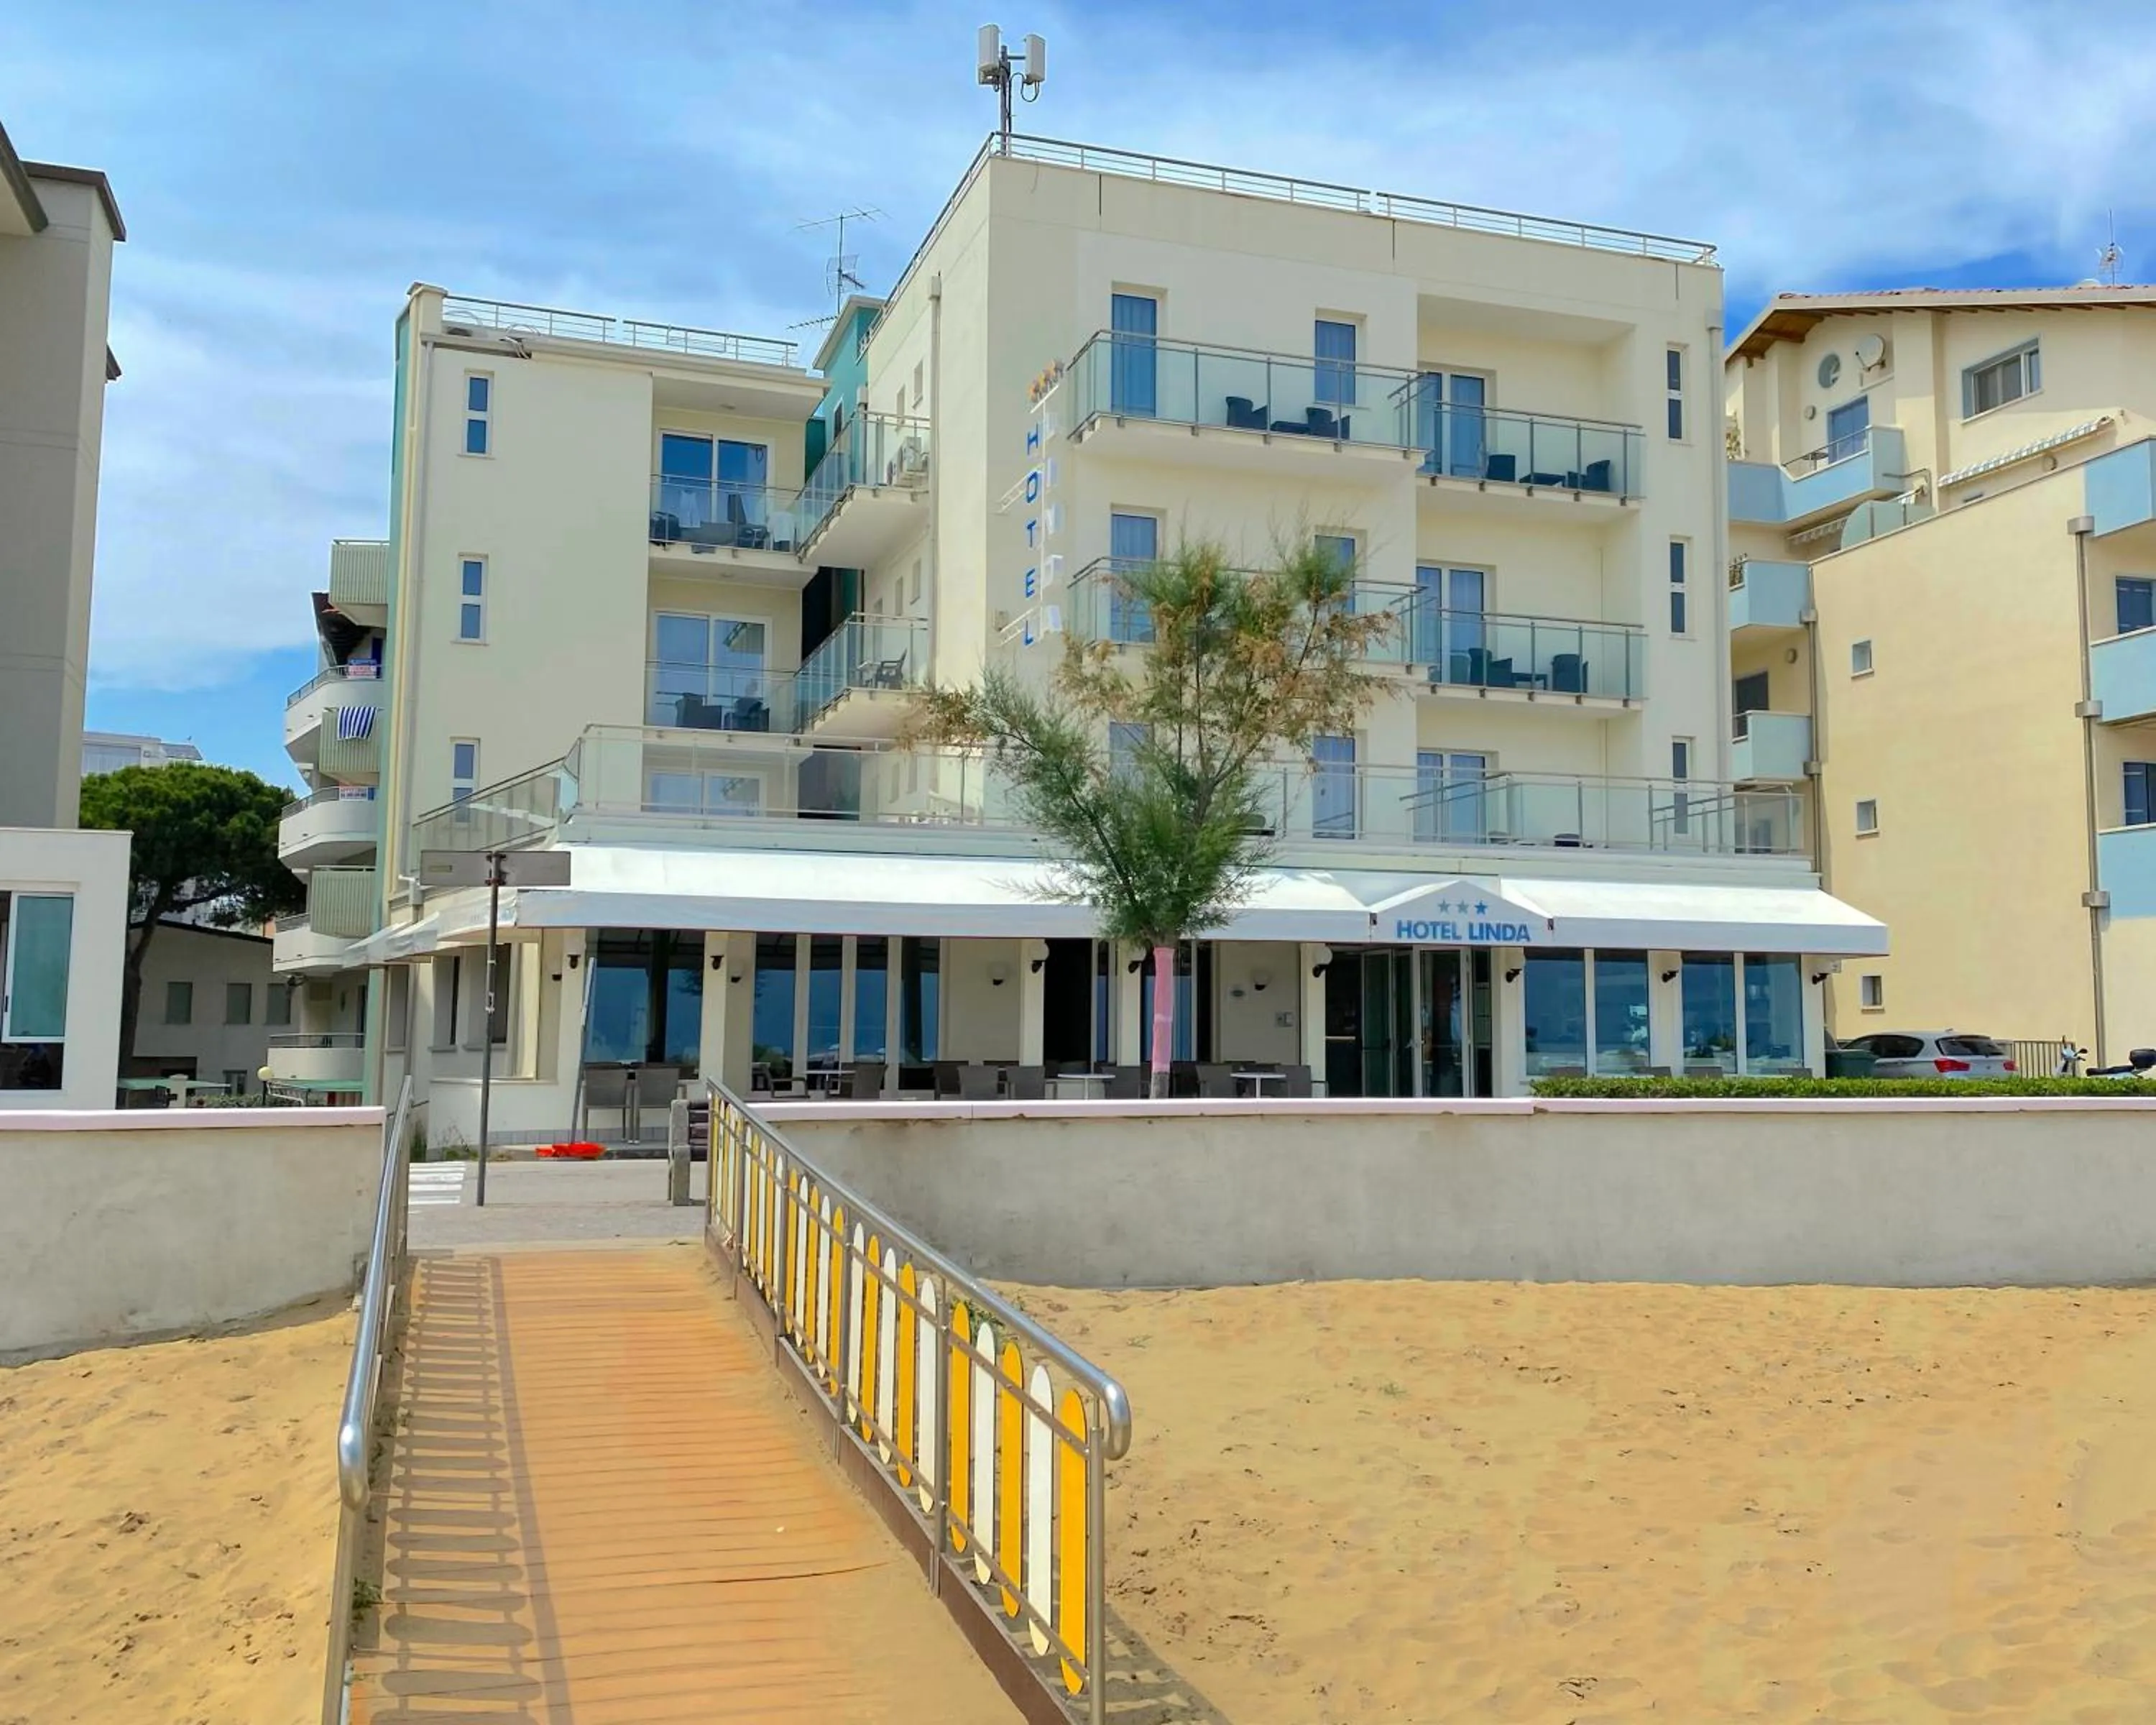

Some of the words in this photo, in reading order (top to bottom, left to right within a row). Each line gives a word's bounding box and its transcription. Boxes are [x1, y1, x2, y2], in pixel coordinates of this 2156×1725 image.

[1025, 423, 1039, 645] HOTEL
[1396, 920, 1462, 940] HOTEL
[1468, 921, 1531, 942] LINDA
